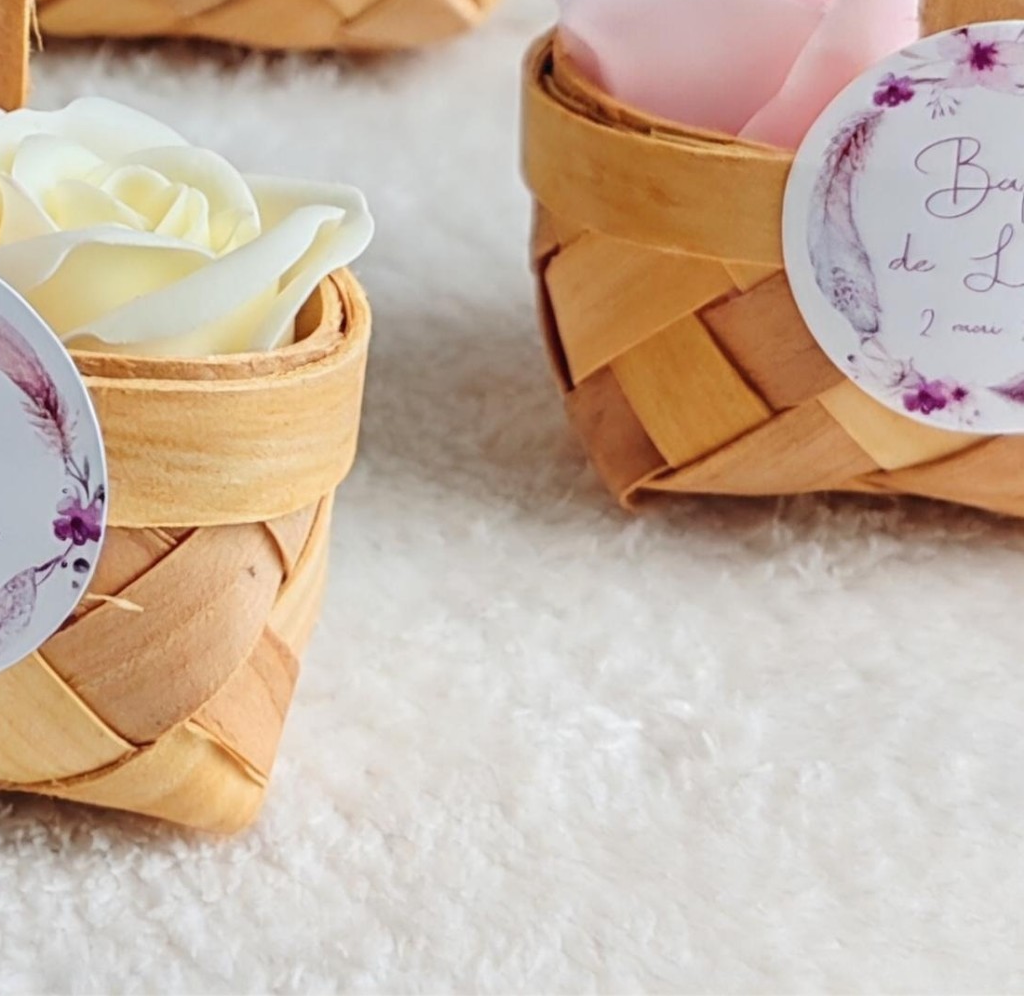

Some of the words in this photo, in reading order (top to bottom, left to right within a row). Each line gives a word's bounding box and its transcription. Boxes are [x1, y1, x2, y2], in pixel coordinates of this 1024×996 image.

[914, 136, 1024, 224] Ba
[888, 233, 936, 273] de
[962, 223, 1024, 293] L
[919, 308, 937, 337] 2
